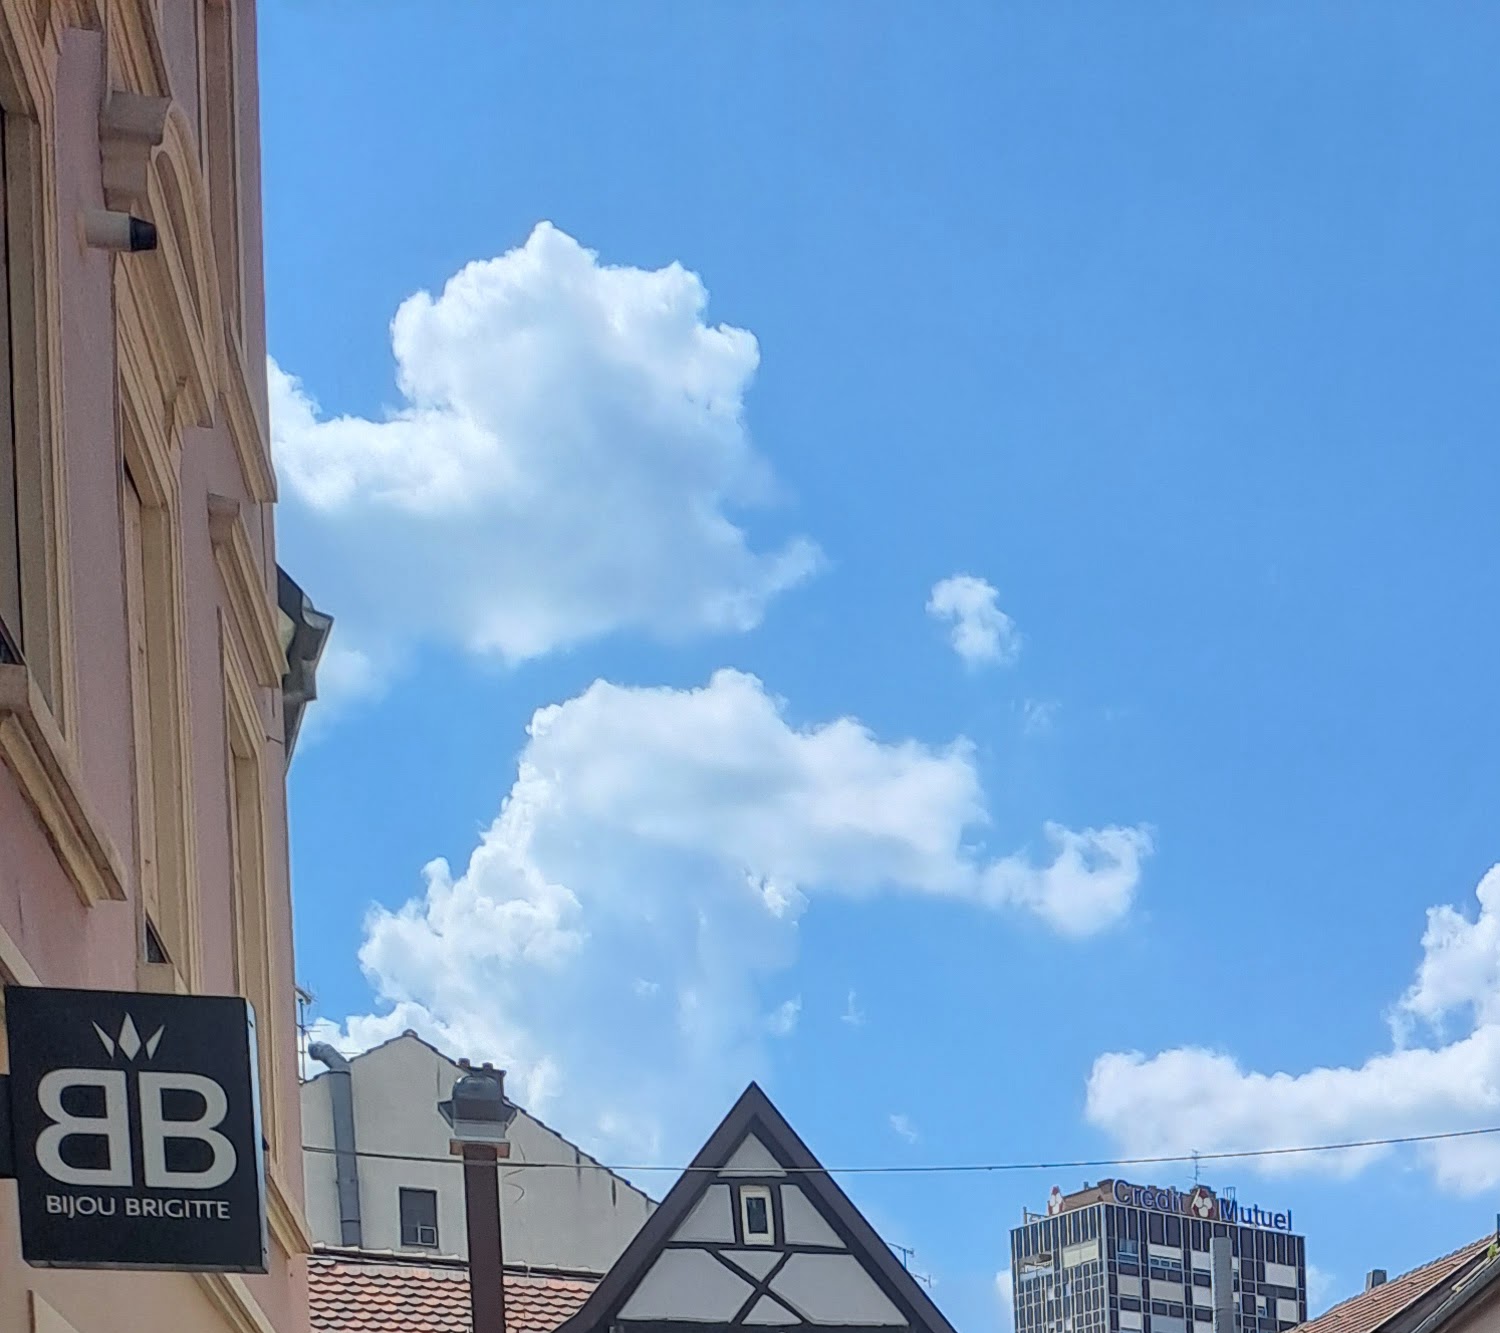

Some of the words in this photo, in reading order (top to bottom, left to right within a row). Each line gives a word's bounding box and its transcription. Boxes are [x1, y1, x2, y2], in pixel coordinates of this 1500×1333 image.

[46, 1195, 115, 1218] BIJOU
[125, 1197, 231, 1220] BRIGITTE
[1218, 1197, 1292, 1232] Mutuel
